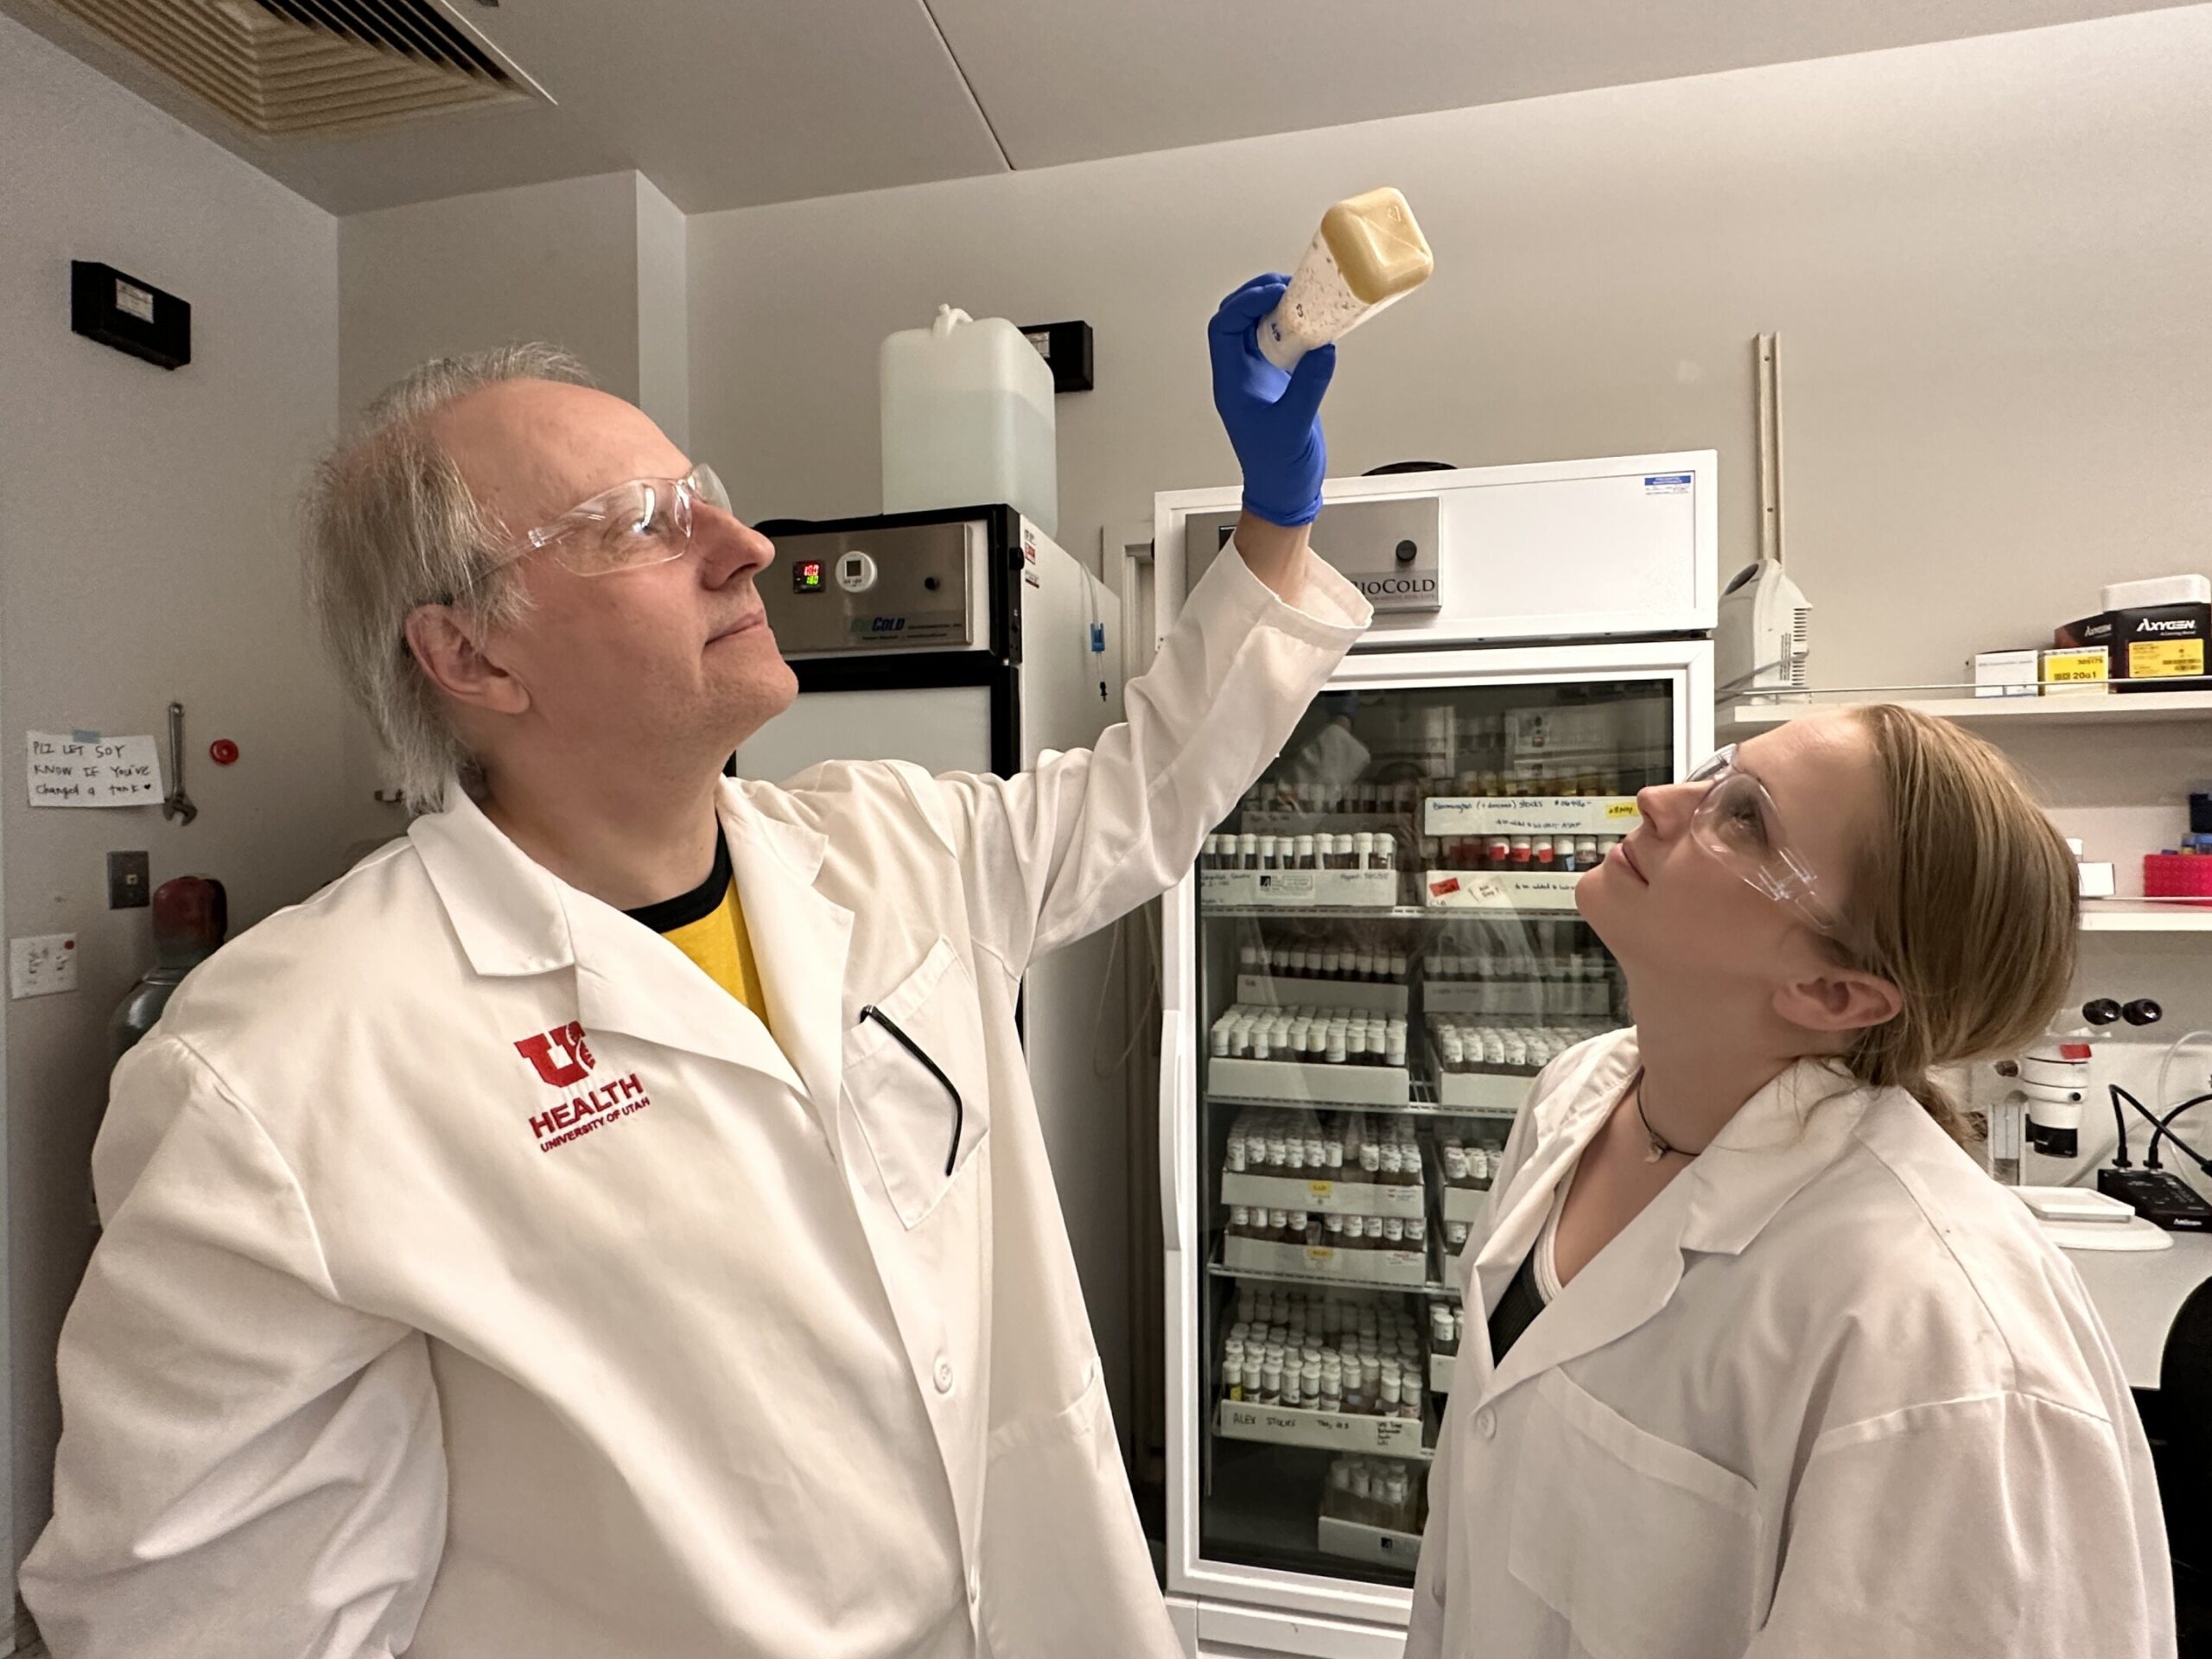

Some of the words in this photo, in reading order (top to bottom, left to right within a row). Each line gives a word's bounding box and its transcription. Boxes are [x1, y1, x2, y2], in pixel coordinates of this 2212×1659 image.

[34, 741, 54, 755] PLZ
[63, 745, 84, 756] LET
[34, 765, 72, 776] KNOW
[88, 787, 95, 796] a
[528, 1073, 644, 1139] HEALTH
[540, 1117, 605, 1153] UNIVERSITY
[607, 1109, 620, 1122] OF
[621, 1096, 650, 1116] UTAH
